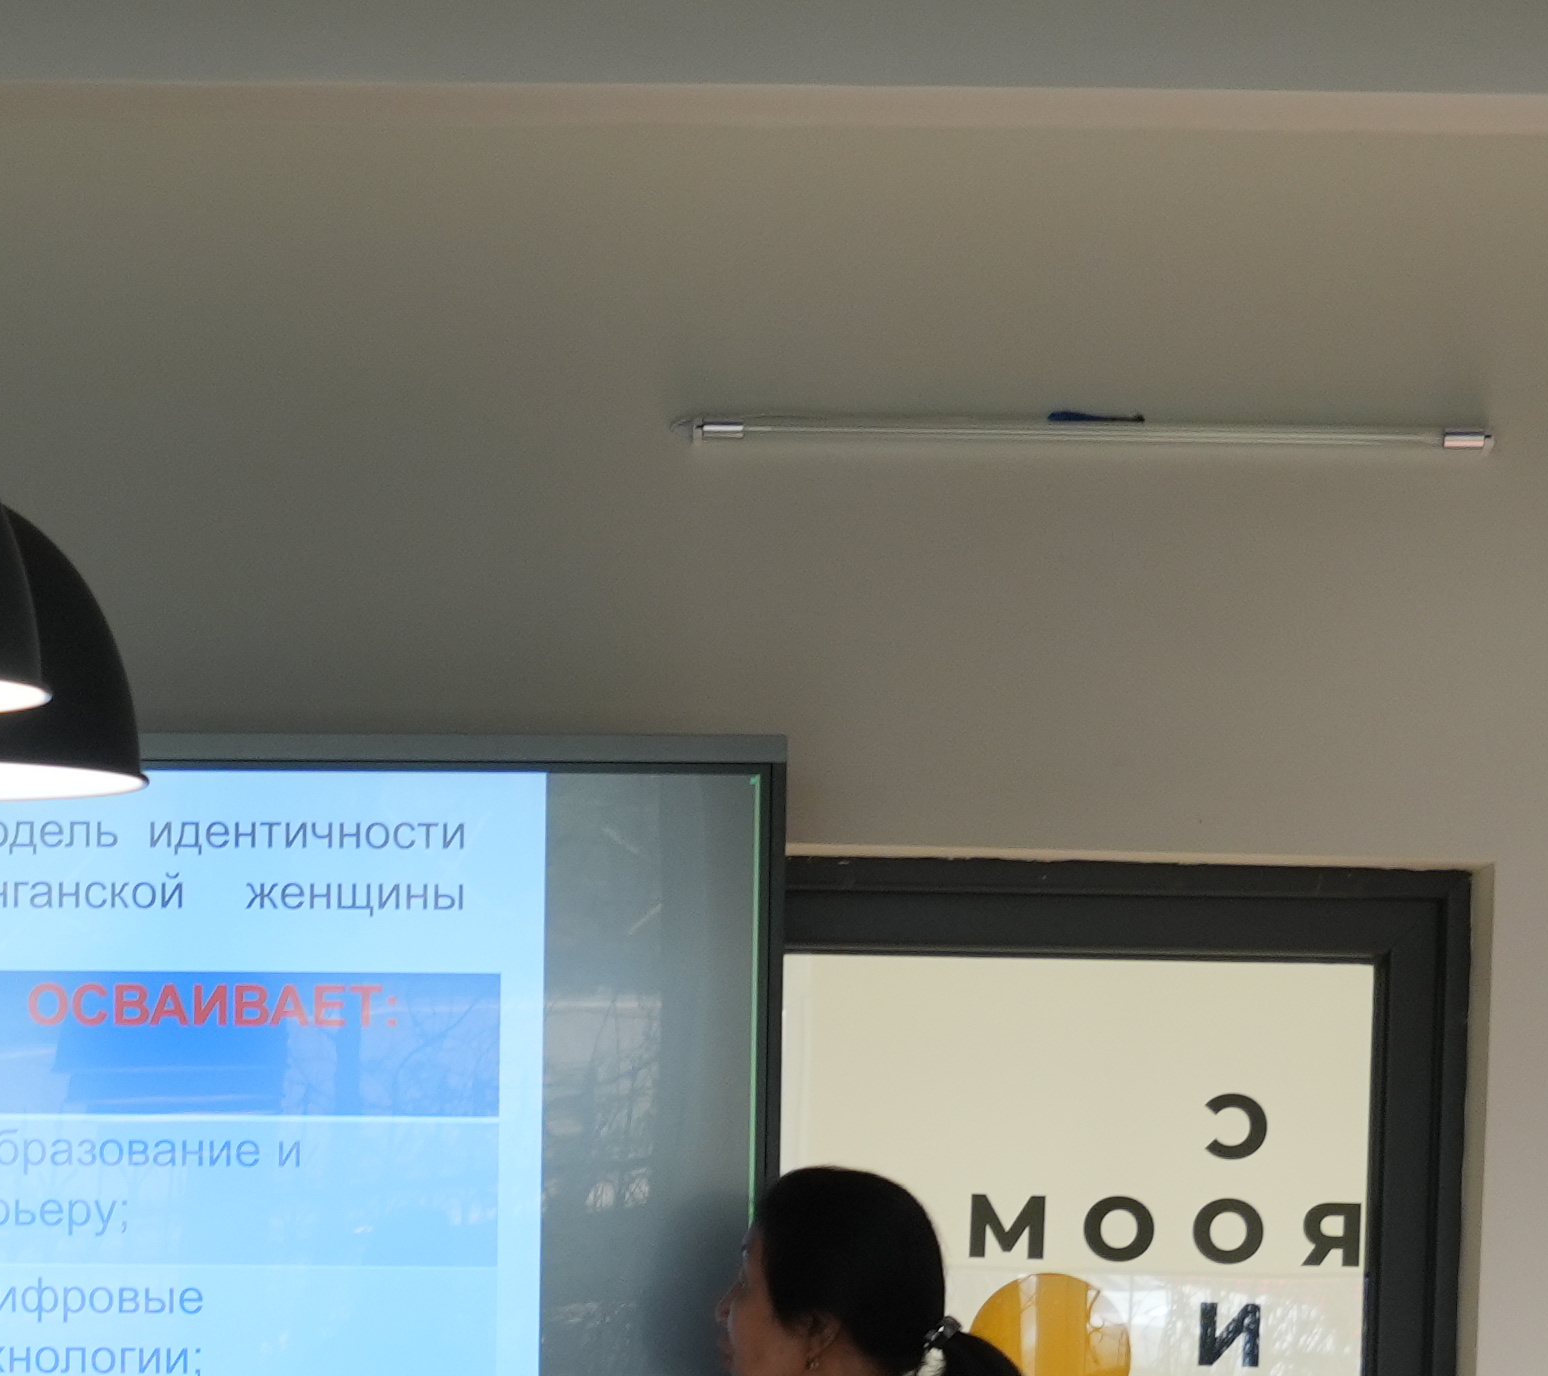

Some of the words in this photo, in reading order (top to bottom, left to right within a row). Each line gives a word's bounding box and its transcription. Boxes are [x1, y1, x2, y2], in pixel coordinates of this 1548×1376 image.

[150, 821, 465, 856] идентичности
[245, 882, 464, 917] женщины
[28, 982, 397, 1027] ОСВАИВАЕТ:
[278, 1141, 301, 1168] и
